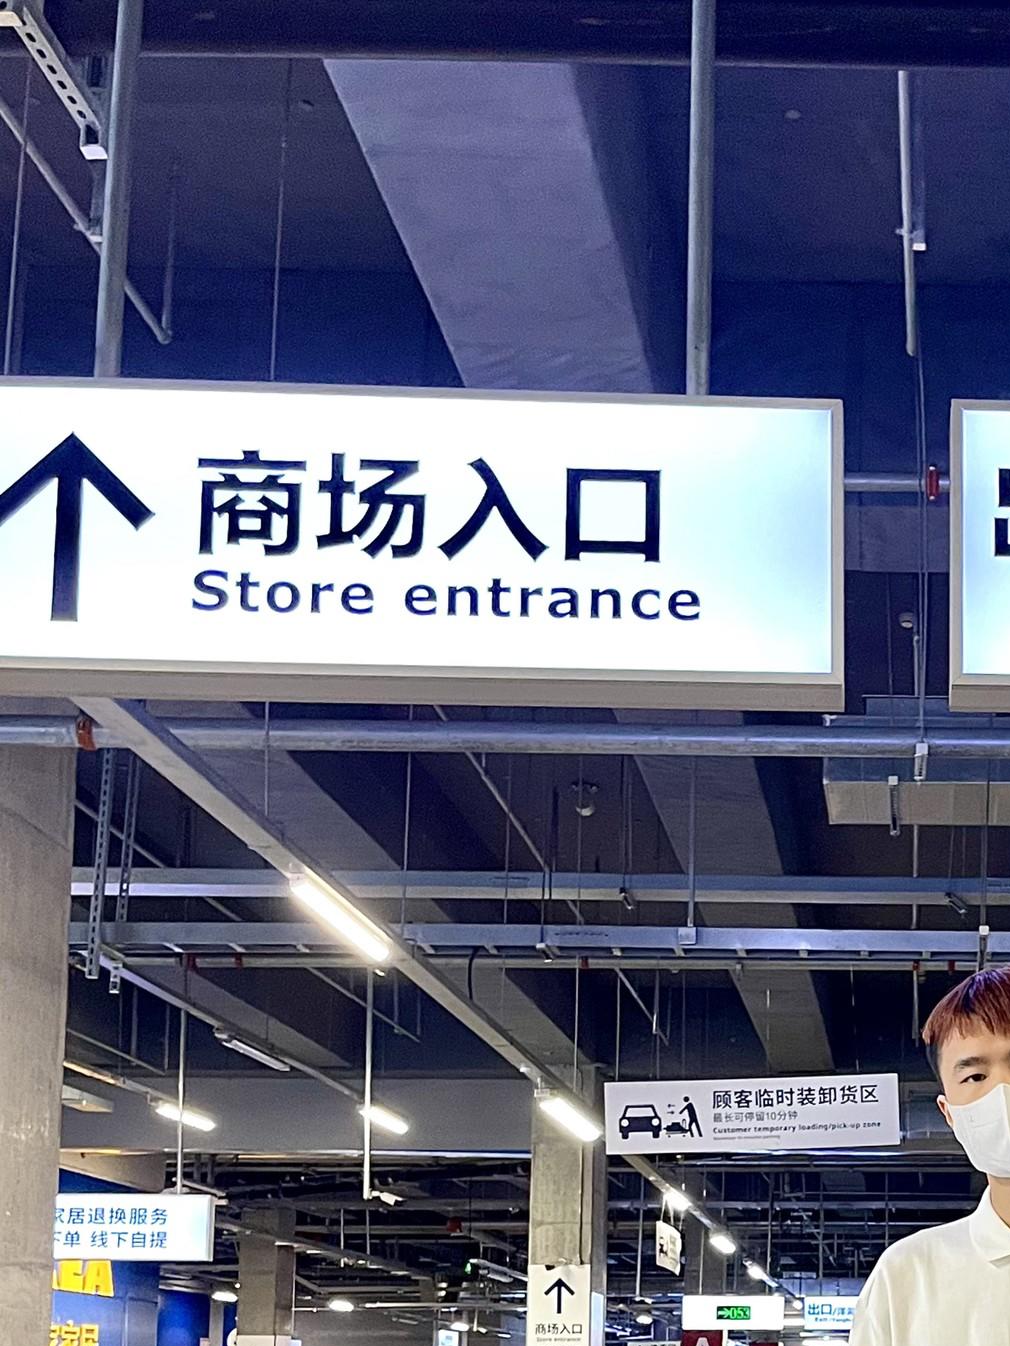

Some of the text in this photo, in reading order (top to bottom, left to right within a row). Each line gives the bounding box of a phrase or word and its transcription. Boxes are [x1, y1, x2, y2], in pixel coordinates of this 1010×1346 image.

[198, 449, 663, 563] 商场入口
[191, 568, 702, 622] Store entrance
[712, 1084, 879, 1109] 顾客临时装卸货区
[713, 1111, 798, 1123] 最长可停留10分钟
[713, 1126, 751, 1134] Customer
[754, 1124, 796, 1134] temporary
[90, 1230, 168, 1249] 线下自提
[535, 1323, 582, 1335] 商场入口
